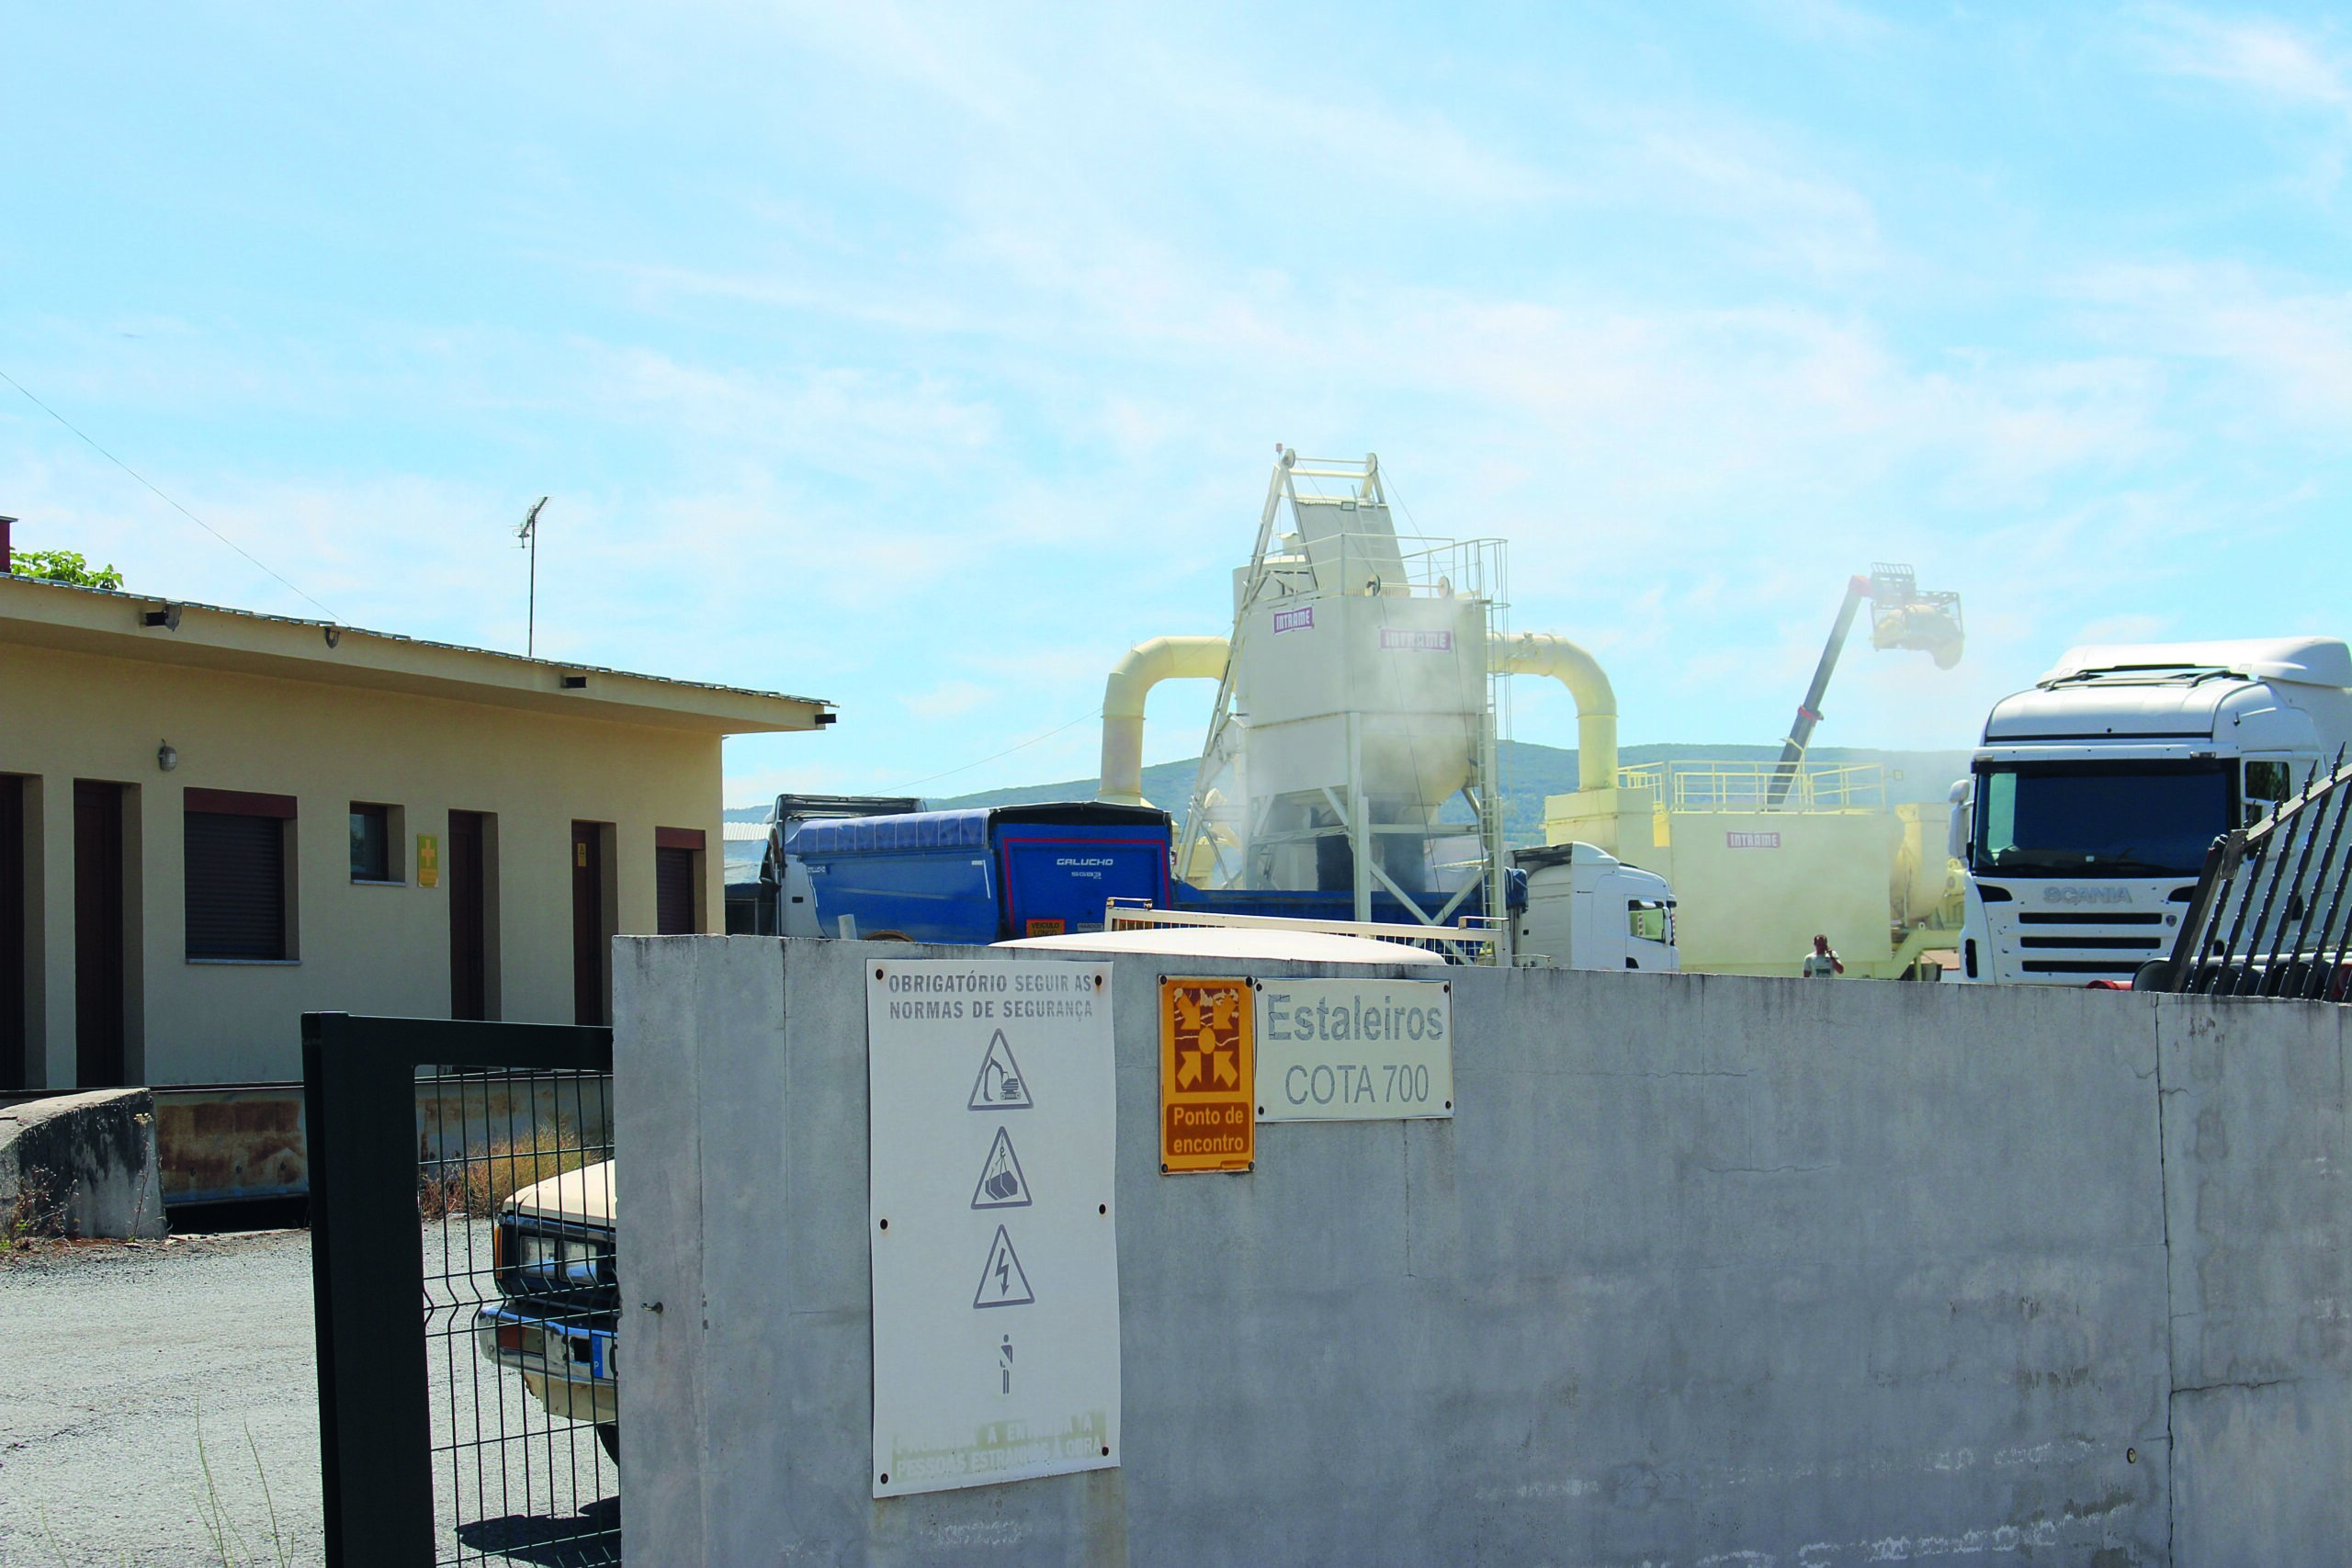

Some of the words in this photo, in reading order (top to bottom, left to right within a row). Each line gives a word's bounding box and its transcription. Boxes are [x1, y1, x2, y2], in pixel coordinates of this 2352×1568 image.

[1057, 858, 1114, 866] GALUCHO
[2042, 886, 2133, 905] SCANIA
[888, 970, 1007, 993] OBRIGATÓRIO
[1014, 975, 1069, 993] SEGUIR
[1074, 975, 1091, 992] AS
[889, 1000, 964, 1020] NORMAS
[972, 1000, 994, 1019] DE
[1002, 999, 1093, 1021] SEGURANÇA
[1268, 994, 1444, 1041] Estaleiros
[1285, 1065, 1376, 1105] COTA
[1383, 1065, 1429, 1103] 700
[1173, 1106, 1220, 1126] Ponto
[1226, 1104, 1244, 1124] de
[1173, 1135, 1244, 1154] encontro
